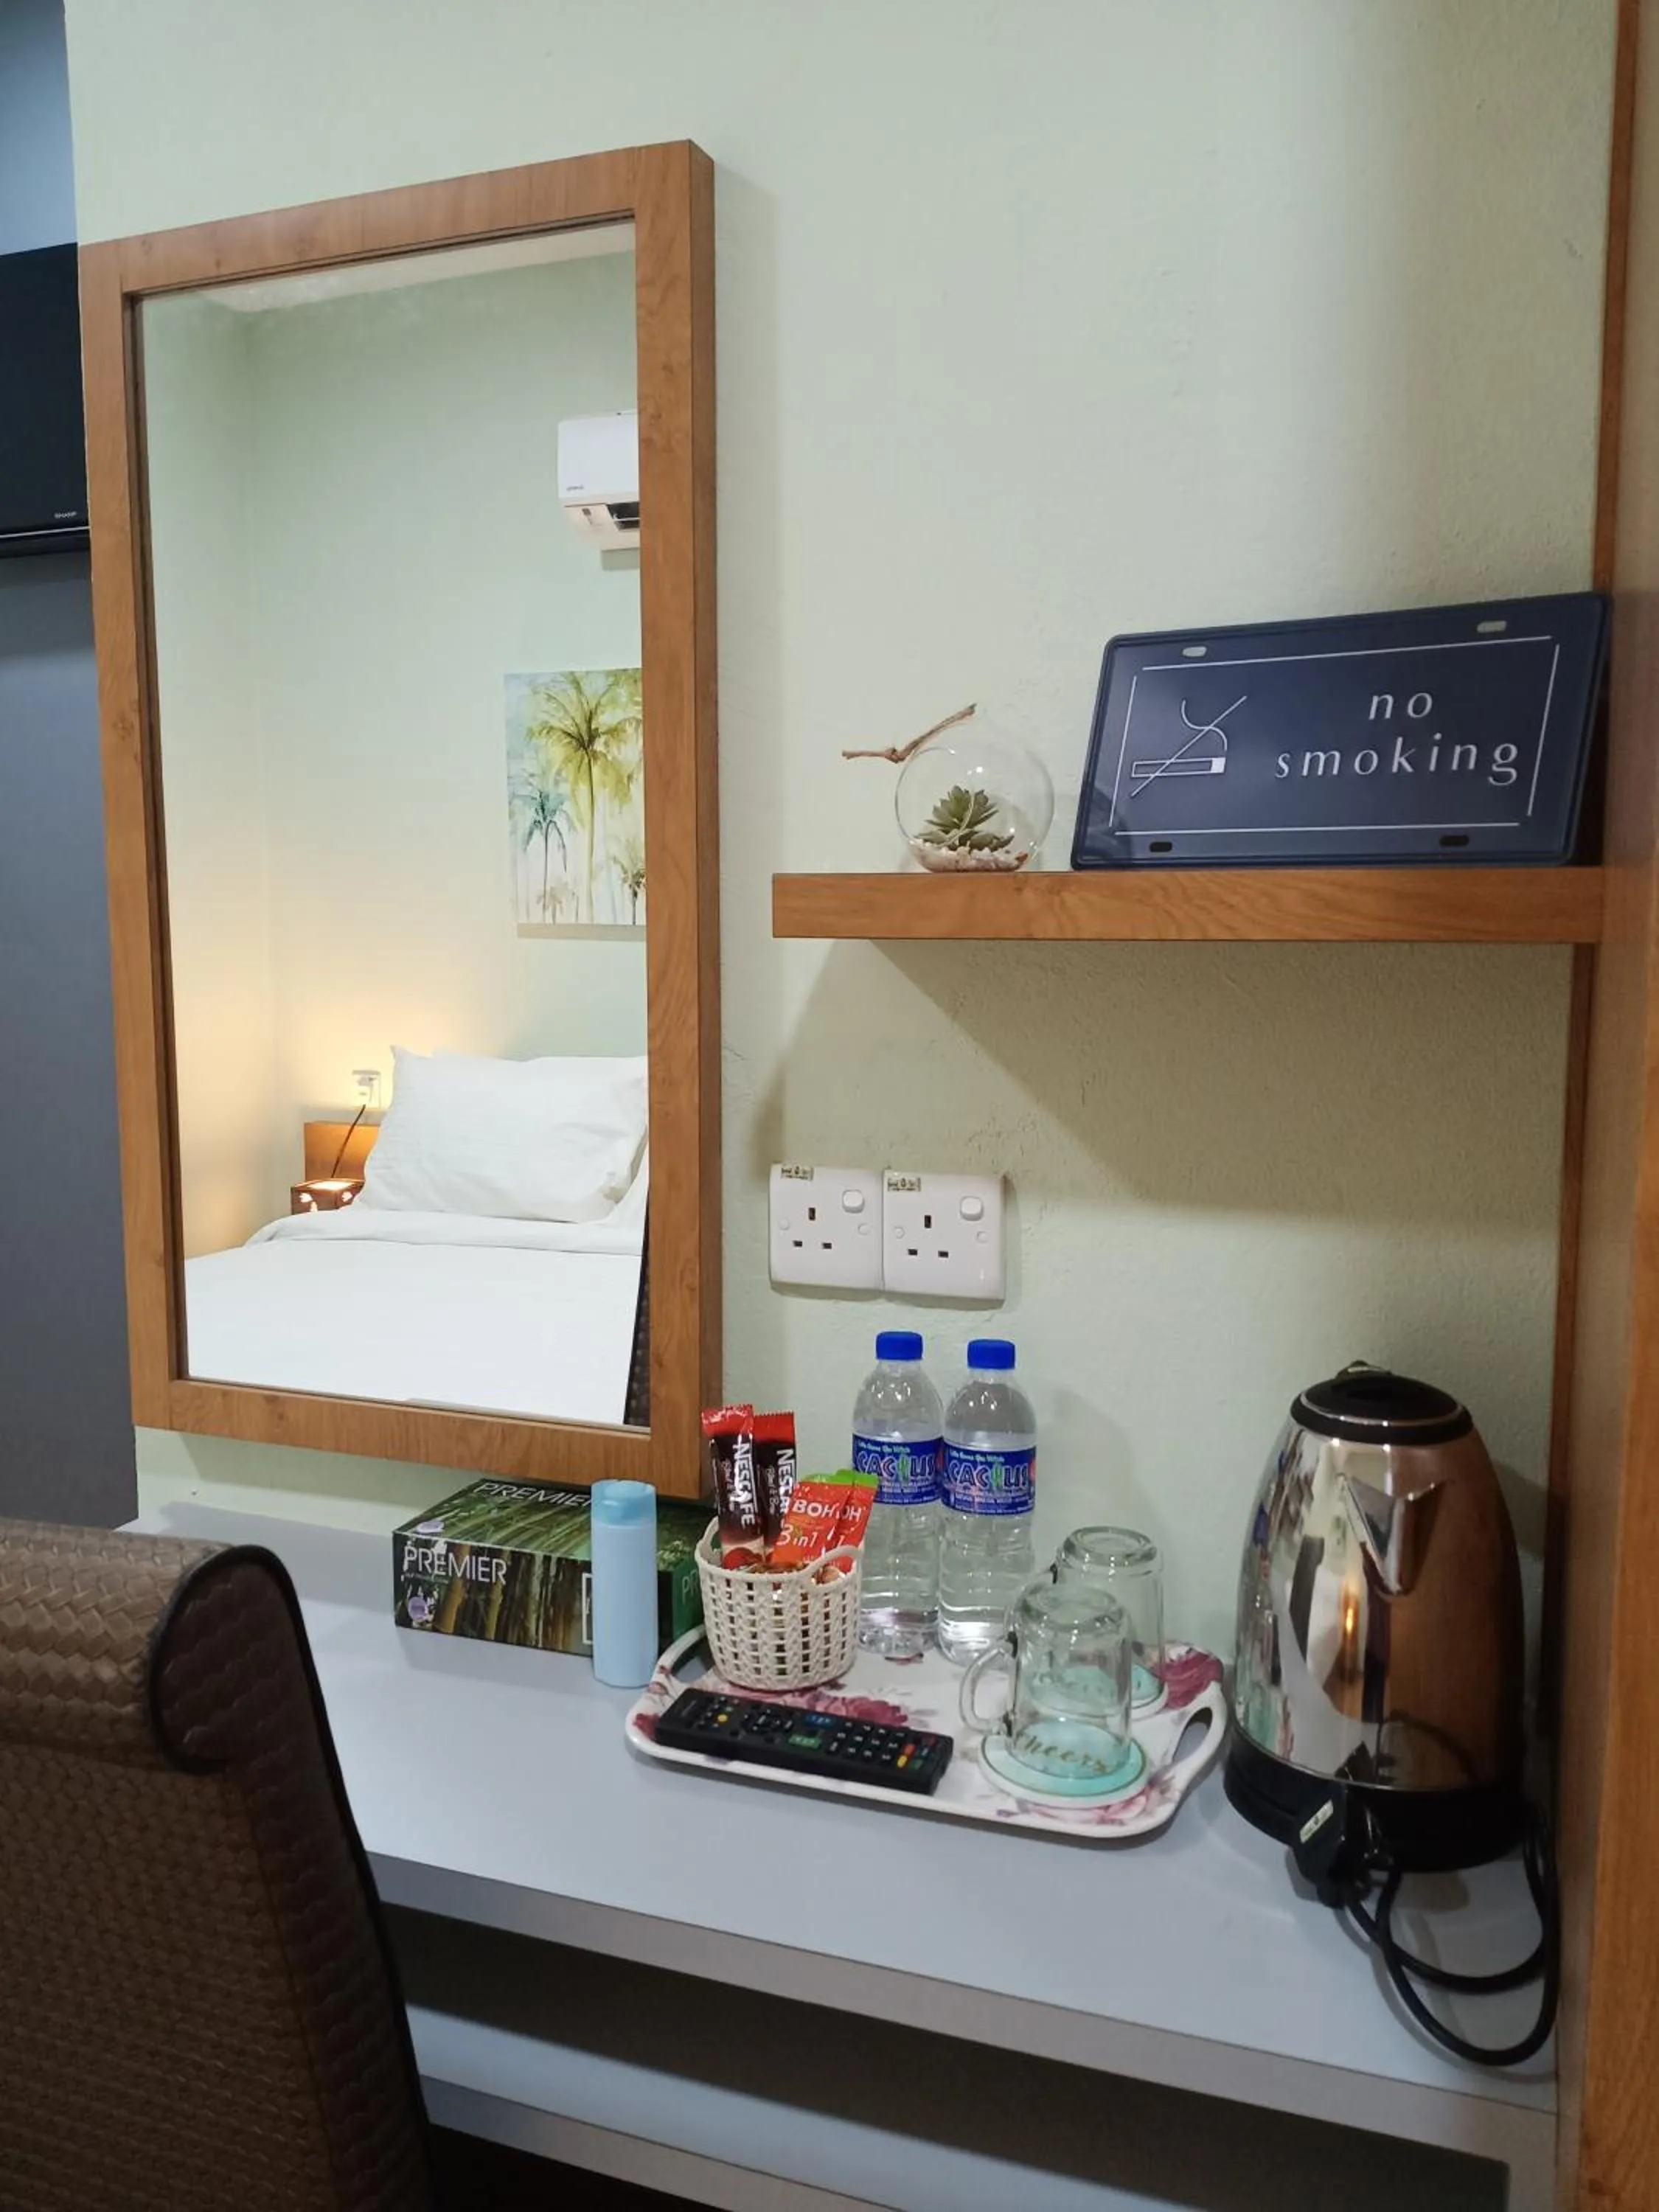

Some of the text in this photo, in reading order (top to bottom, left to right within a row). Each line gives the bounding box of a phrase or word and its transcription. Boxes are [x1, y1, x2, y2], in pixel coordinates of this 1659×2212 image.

[1368, 692, 1433, 720] no
[1275, 732, 1517, 786] smoking
[792, 1499, 839, 1517] BOH
[403, 1545, 507, 1585] PREMIER
